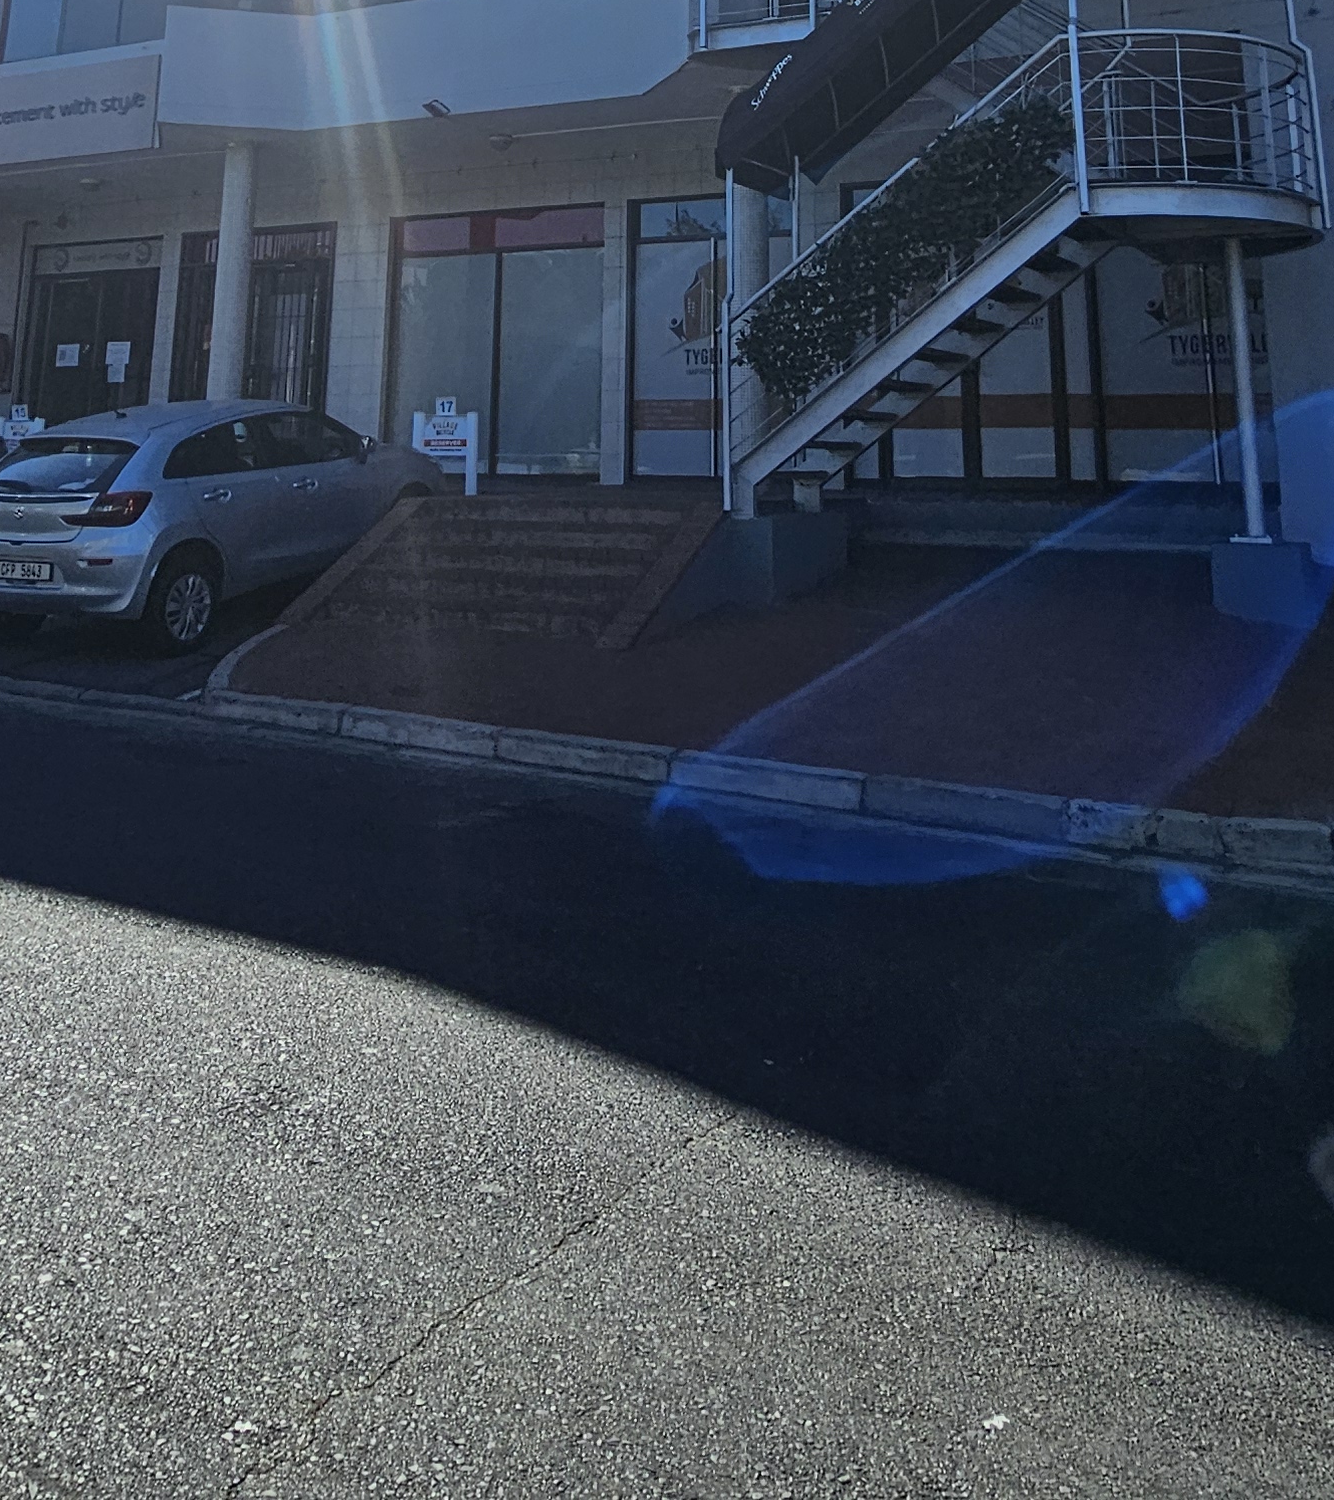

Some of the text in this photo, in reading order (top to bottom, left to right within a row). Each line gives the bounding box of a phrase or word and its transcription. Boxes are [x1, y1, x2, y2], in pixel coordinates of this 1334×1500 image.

[59, 97, 98, 118] with
[99, 91, 147, 116] style
[440, 400, 454, 413] 17
